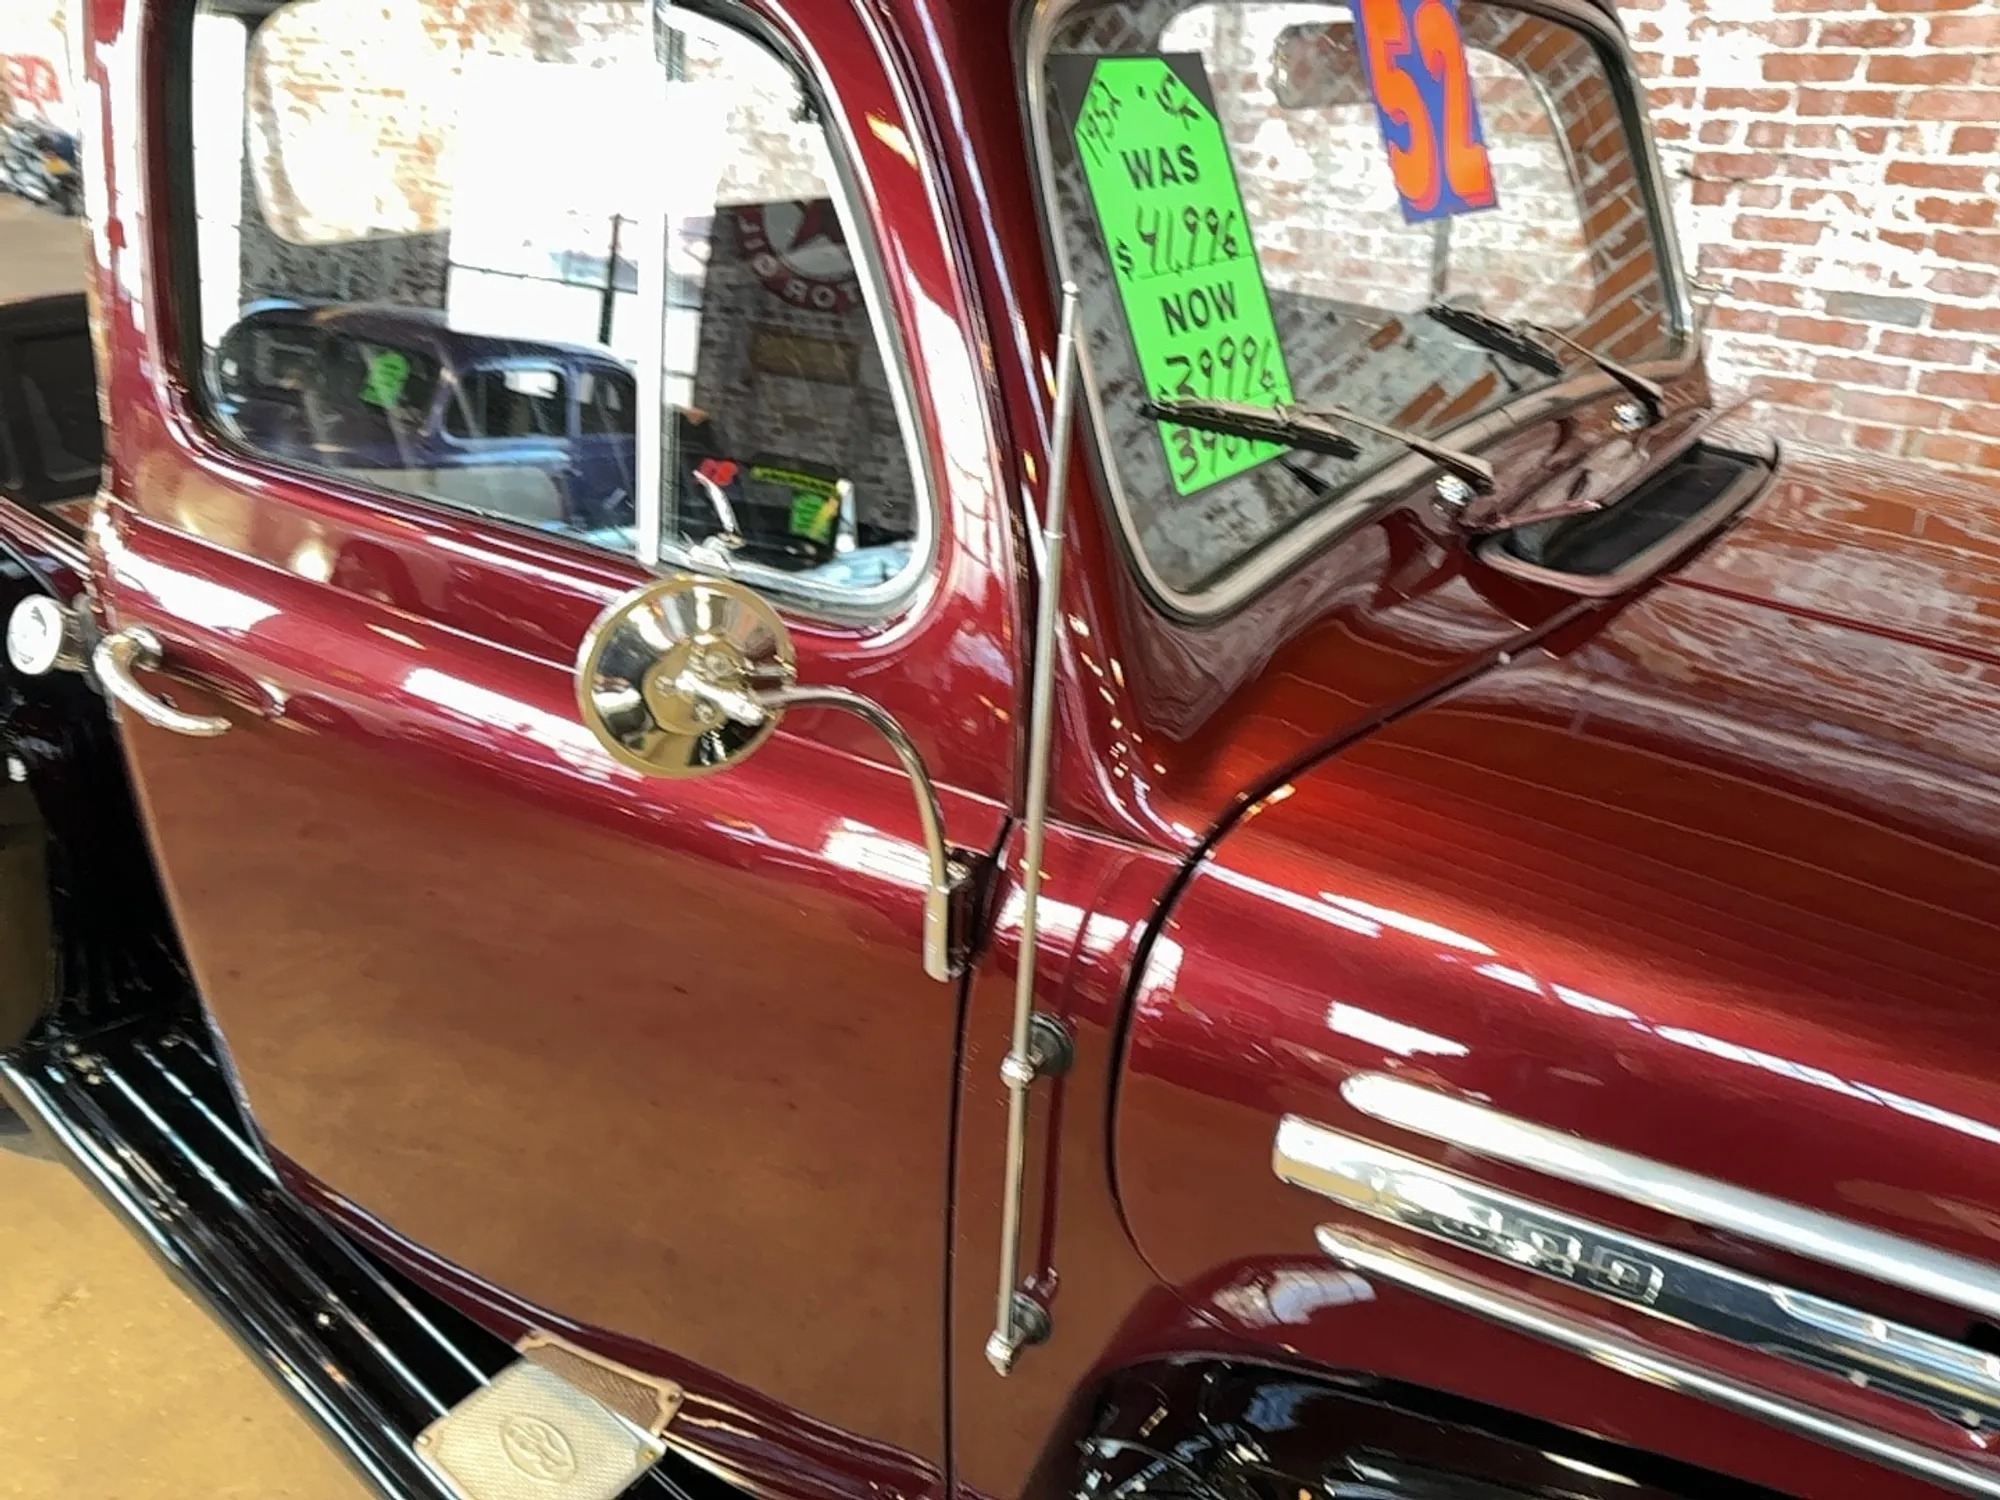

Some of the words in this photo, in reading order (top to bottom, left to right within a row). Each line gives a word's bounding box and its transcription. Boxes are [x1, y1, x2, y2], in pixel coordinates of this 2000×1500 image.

[1359, 0, 1492, 208] 52
[1119, 143, 1200, 191] WAS
[1160, 280, 1238, 337] NOW
